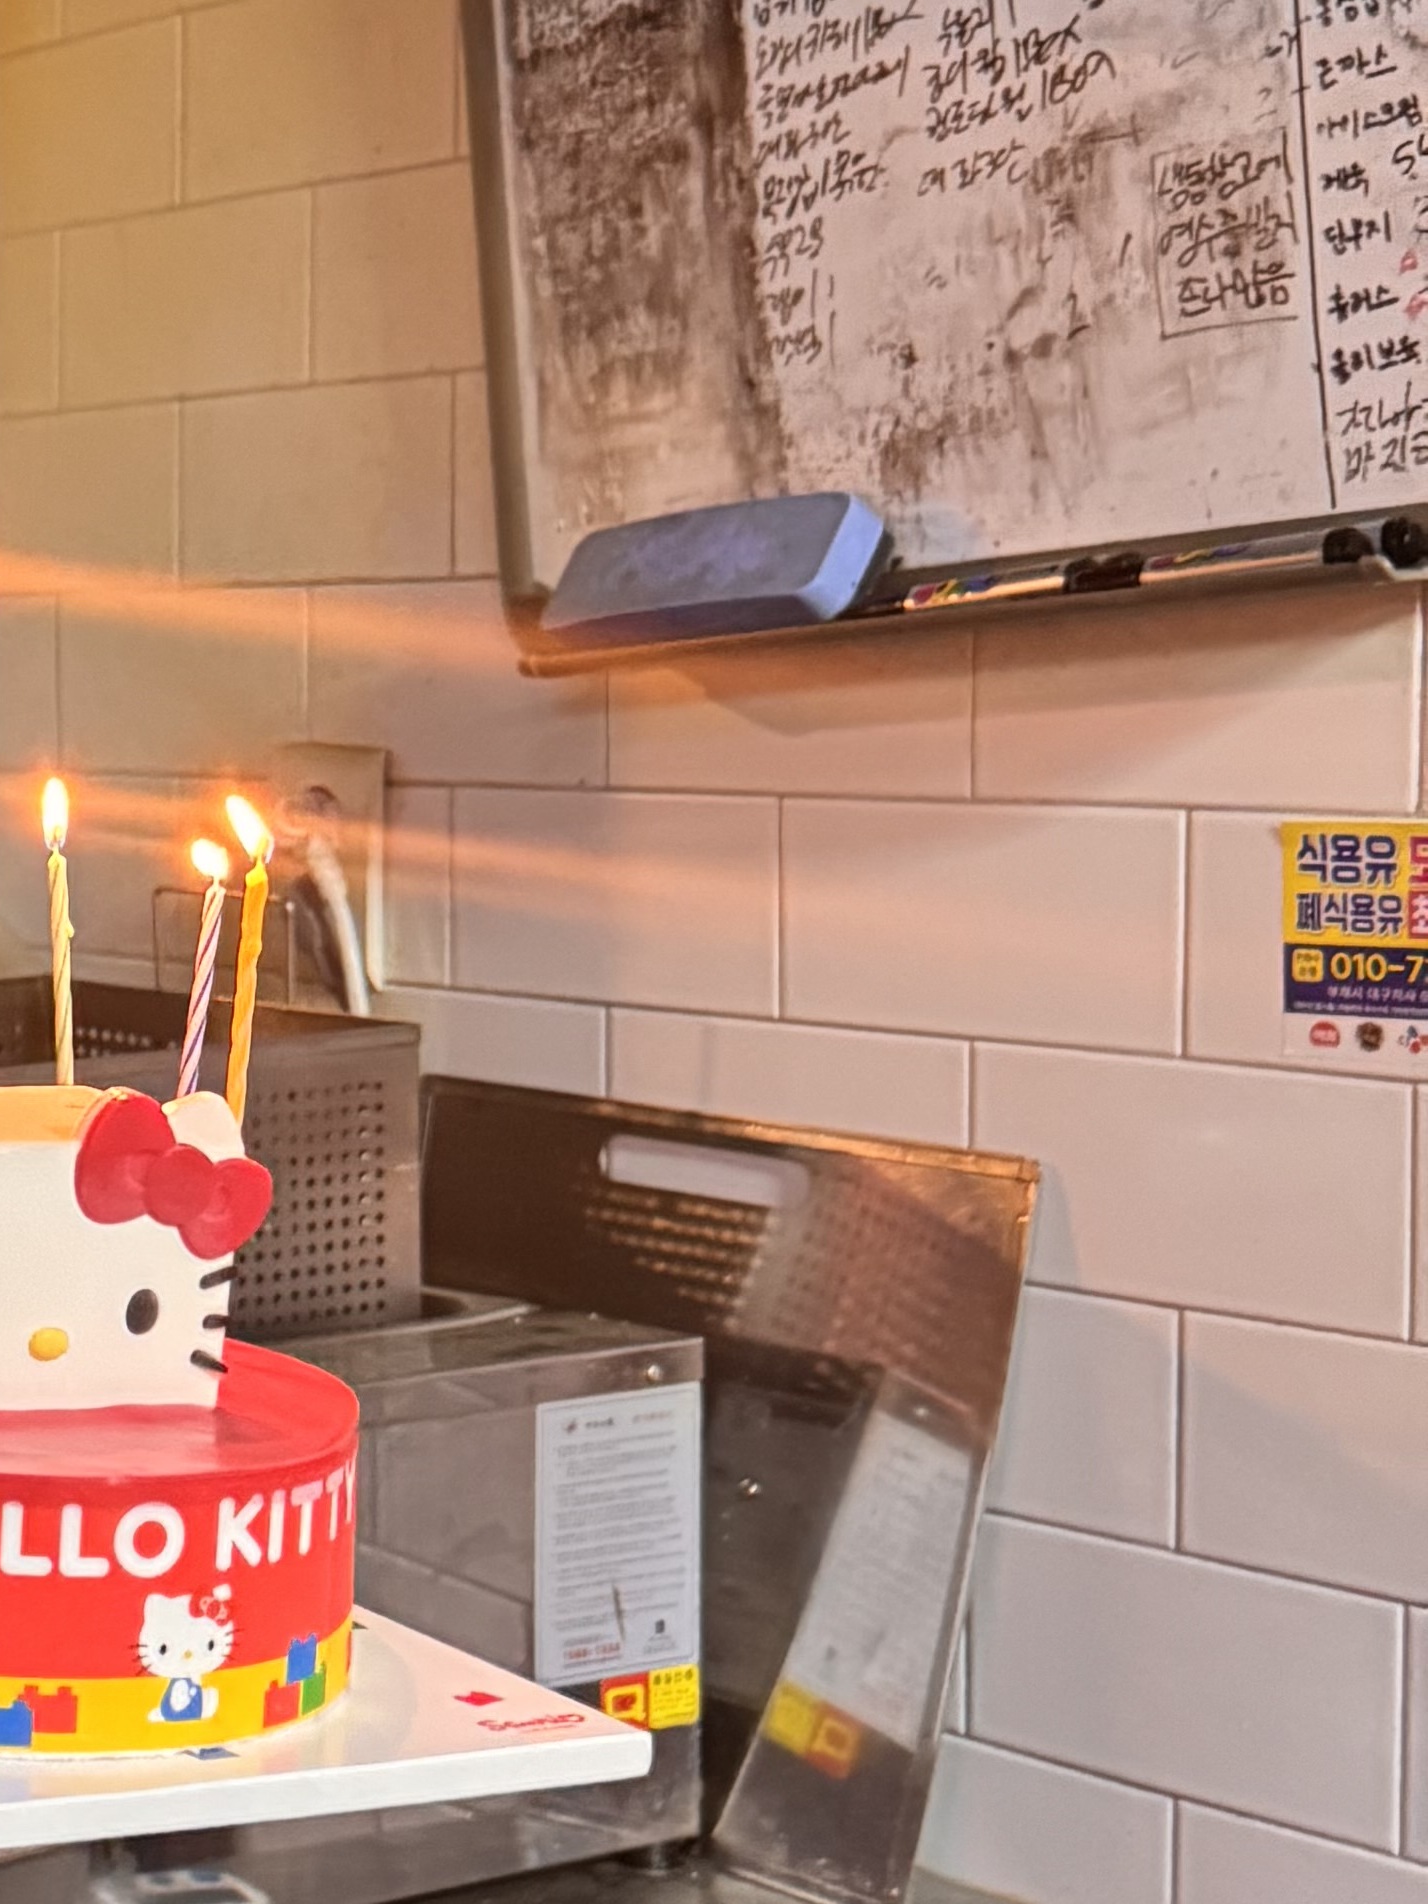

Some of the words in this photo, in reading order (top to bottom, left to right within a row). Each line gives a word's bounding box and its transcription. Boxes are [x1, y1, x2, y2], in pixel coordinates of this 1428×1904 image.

[1297, 833, 1397, 886] 식용유
[1296, 892, 1404, 935] 폐식용유
[1330, 952, 1428, 985] 010-7
